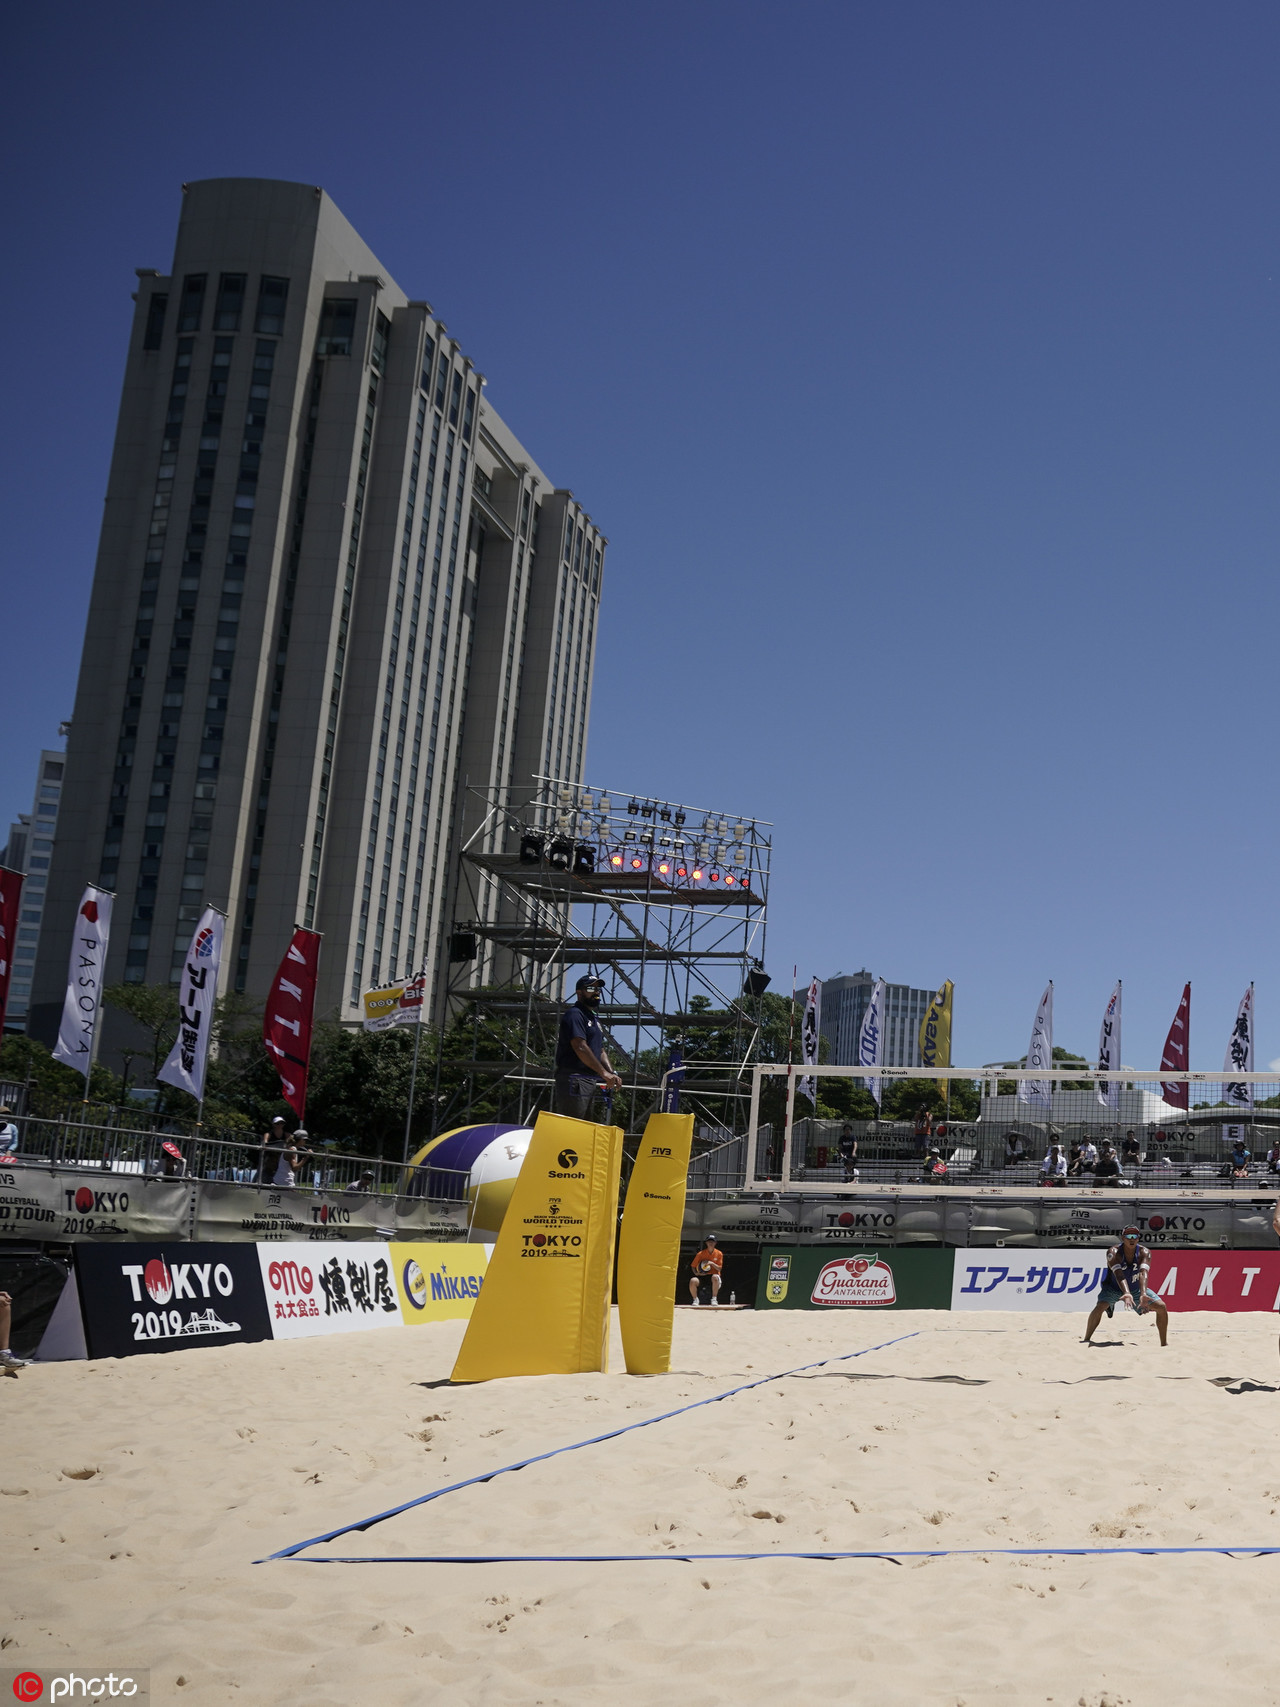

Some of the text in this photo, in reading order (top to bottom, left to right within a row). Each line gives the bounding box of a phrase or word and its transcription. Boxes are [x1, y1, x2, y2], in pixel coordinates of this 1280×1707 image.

[75, 937, 97, 1053] PASONA
[1030, 1016, 1044, 1096] PASOA
[930, 1125, 977, 1138] TOKYO
[1147, 1131, 1195, 1142] TOKYO
[1228, 1126, 1239, 1138] E
[929, 1138, 949, 1147] 2019
[651, 1147, 671, 1155] FIVB
[548, 1170, 585, 1179] Senoh
[0, 1196, 40, 1206] OLLEYBALL
[65, 1187, 129, 1214] TOKYO
[14, 1207, 56, 1223] TOUR
[311, 1204, 350, 1224] TOKYO
[760, 1206, 779, 1214] FIVB
[1071, 1210, 1090, 1218] FIVB
[63, 1218, 94, 1233] 2019
[241, 1219, 304, 1231] WORLD TOUR
[826, 1212, 896, 1227] TOKYO
[1136, 1215, 1205, 1231] TOKYO
[309, 1227, 328, 1239] 2019
[777, 1225, 814, 1233] TOUR
[825, 1229, 854, 1238] 2019
[521, 1234, 582, 1247] TOKYO
[1139, 1233, 1166, 1243] 2019
[521, 1249, 548, 1257] 2019
[1132, 1263, 1138, 1271] 2
[122, 1257, 233, 1305] TOKYO
[319, 1257, 398, 1315] 燻製屋
[820, 1271, 889, 1295] Guaraná
[960, 1266, 1108, 1294] エアーサロン
[274, 1299, 320, 1319] 丸大食品
[131, 1311, 183, 1341] 2019
